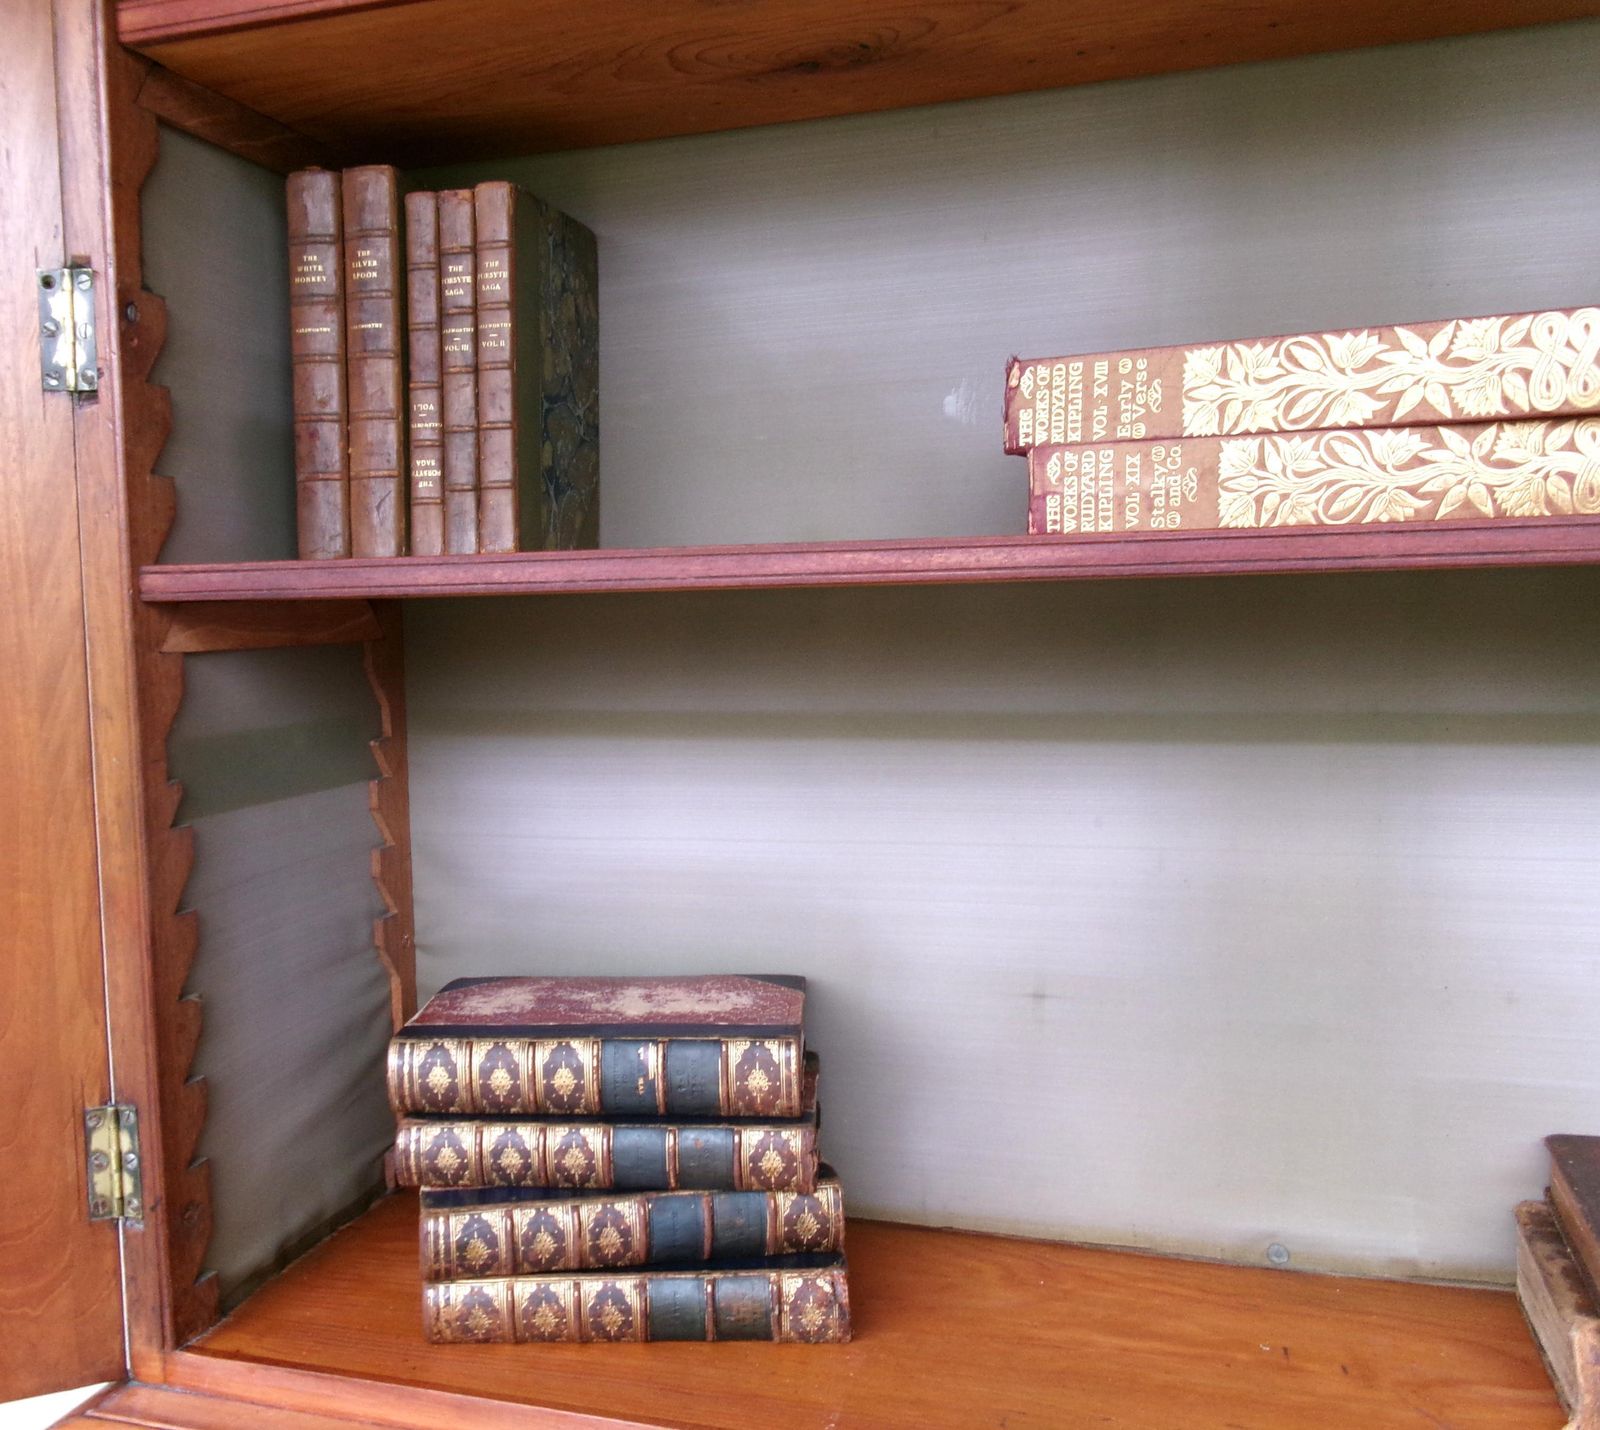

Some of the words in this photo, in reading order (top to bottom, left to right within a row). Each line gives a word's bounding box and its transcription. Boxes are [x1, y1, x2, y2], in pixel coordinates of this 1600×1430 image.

[295, 275, 327, 284] MONKEY
[297, 264, 324, 273] WHITE
[352, 260, 378, 268] SILVER
[352, 271, 378, 280] SPOON
[445, 288, 464, 297] SAGA
[482, 283, 501, 291] SAGA
[444, 344, 460, 352] VOL
[482, 340, 498, 348] VOL
[1094, 360, 1109, 398] XVIII
[1132, 357, 1148, 421] Verse
[418, 403, 434, 411] VOL
[1051, 363, 1067, 445] RUDYARD
[1067, 361, 1084, 443] KIPLING
[1117, 379, 1135, 439] Early
[1019, 408, 1034, 447] THE
[1093, 405, 1108, 442] VOL
[419, 480, 434, 488] THE
[1126, 452, 1141, 486] XIX
[1081, 450, 1096, 533] RUDYARD
[1098, 449, 1114, 533] KIPLING
[1151, 463, 1169, 529] Stalky
[1046, 494, 1061, 533] THE
[1126, 492, 1140, 530] VOL
